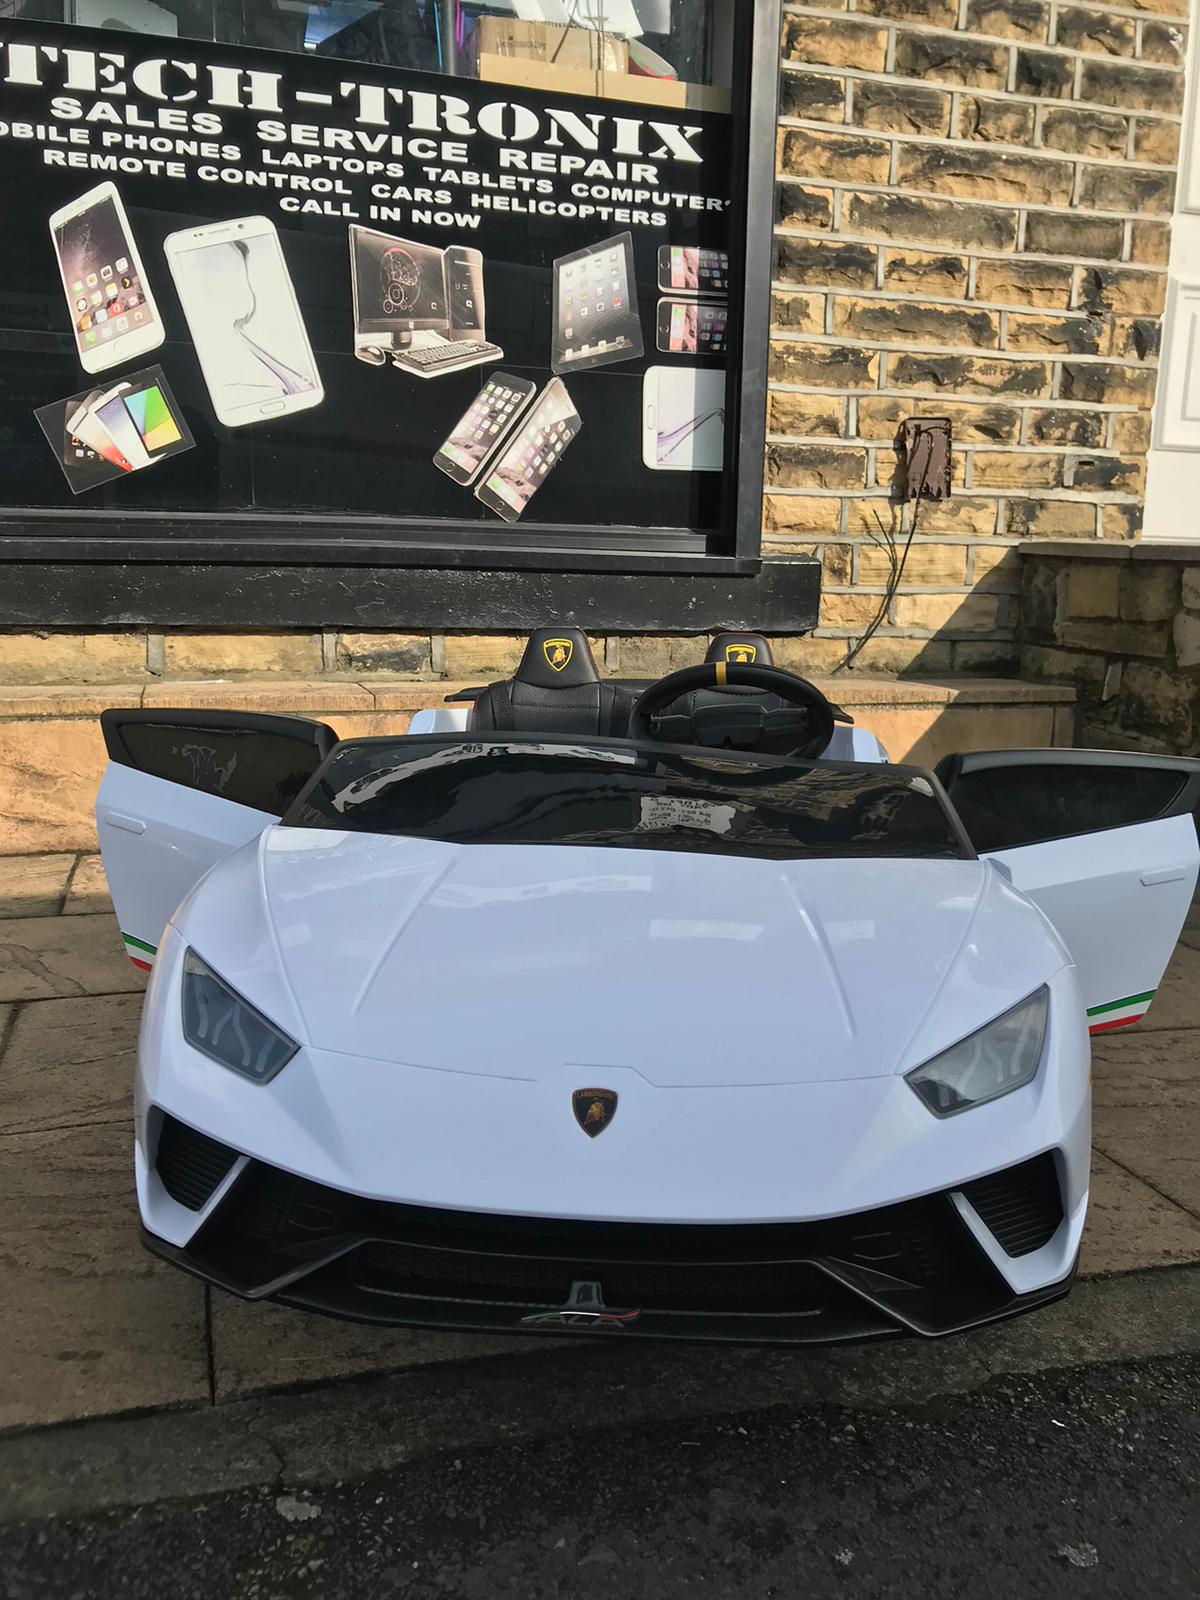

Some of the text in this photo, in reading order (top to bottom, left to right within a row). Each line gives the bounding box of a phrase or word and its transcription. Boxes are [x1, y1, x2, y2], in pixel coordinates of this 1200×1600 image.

[0, 43, 703, 164] TECH-TRONIX
[50, 96, 660, 185] SALES SERVICE REPAIR
[43, 149, 667, 227] REMOTE CONTROL CARS HELICOPTERS
[102, 131, 242, 161] PHONES
[262, 148, 405, 179] LAPTOPS
[423, 166, 554, 195] TABLETS
[279, 196, 482, 229] CALL IN NOW
